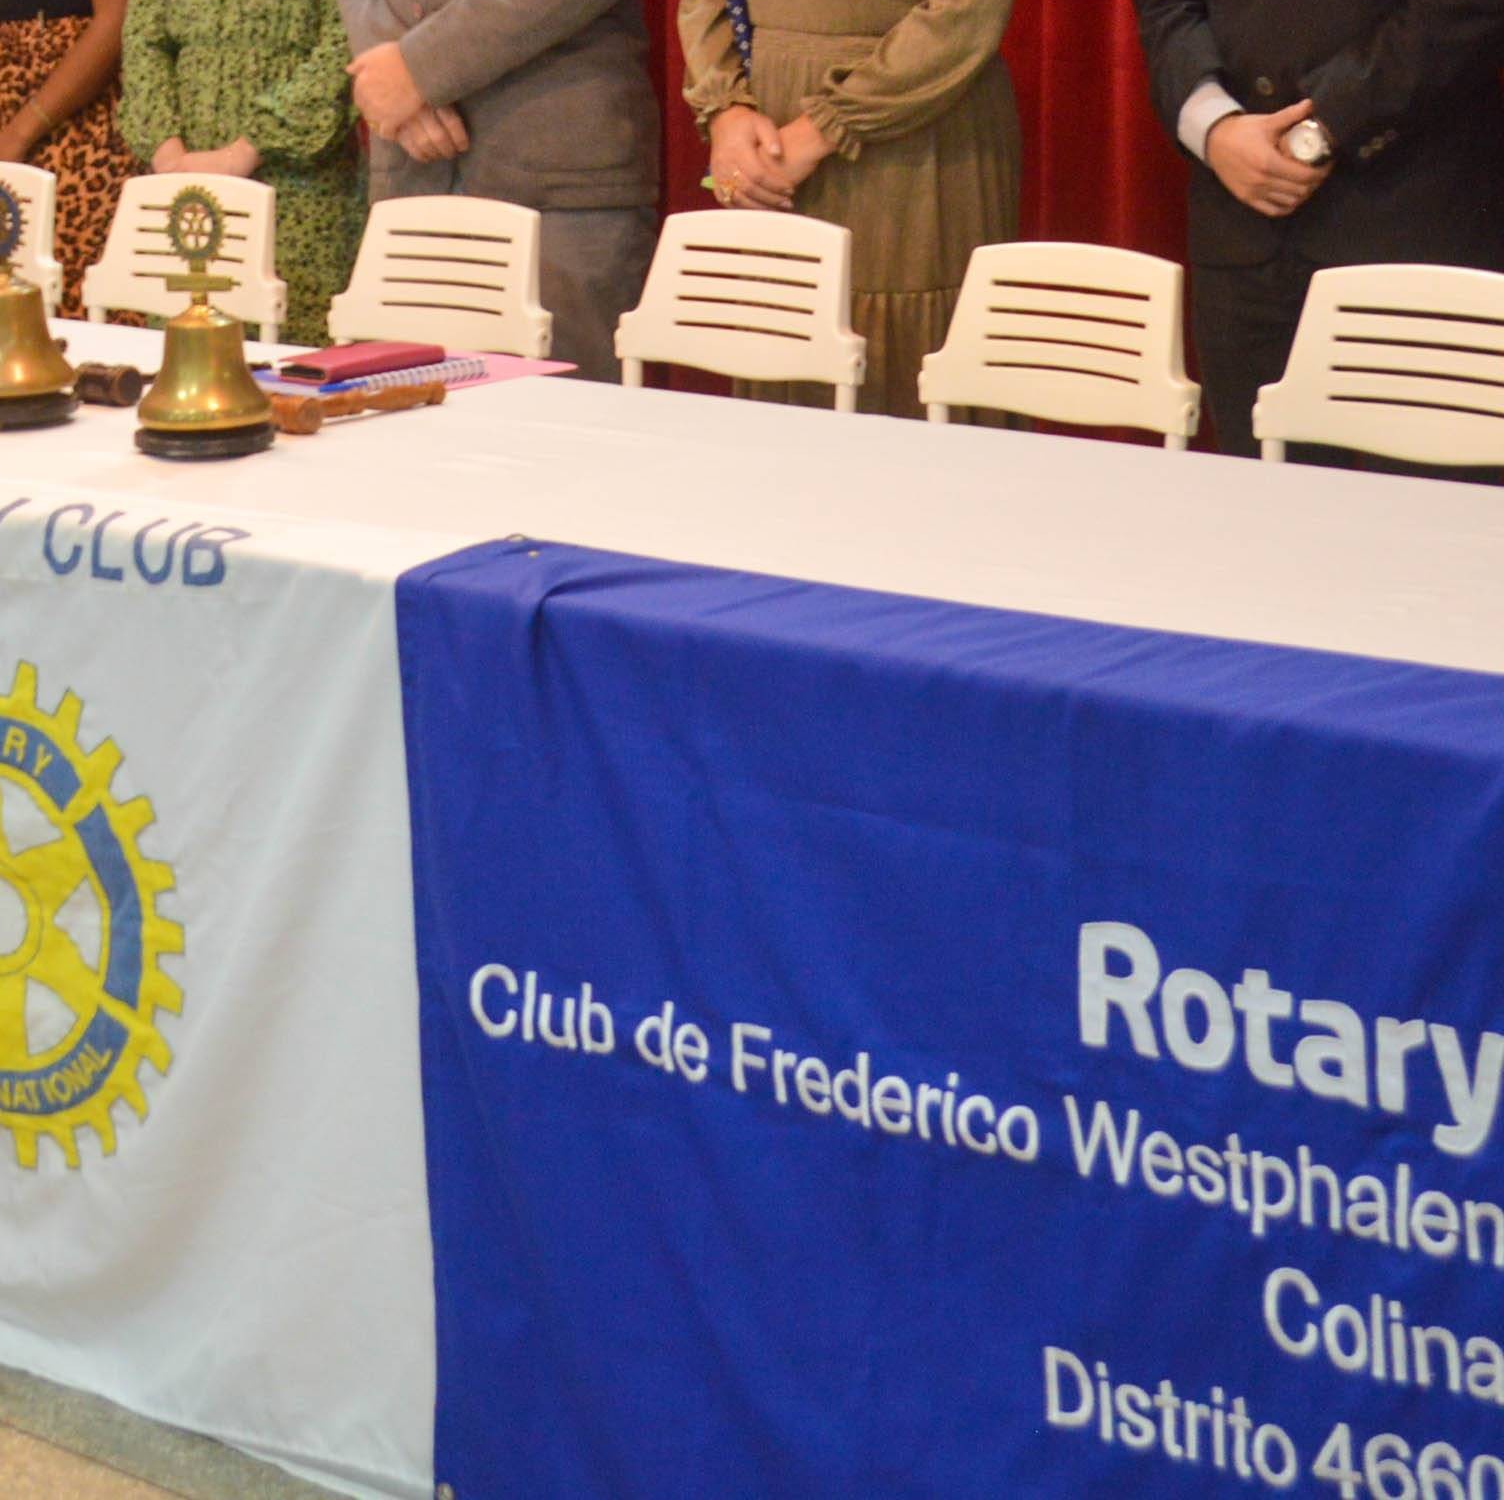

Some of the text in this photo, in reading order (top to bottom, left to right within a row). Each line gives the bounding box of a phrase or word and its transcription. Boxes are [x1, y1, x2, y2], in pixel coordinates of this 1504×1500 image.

[42, 503, 252, 587] CLUB
[469, 964, 616, 1053] Club
[635, 1002, 710, 1082] de
[731, 1023, 1040, 1162] Frederico
[1044, 1346, 1297, 1487] Distrito
